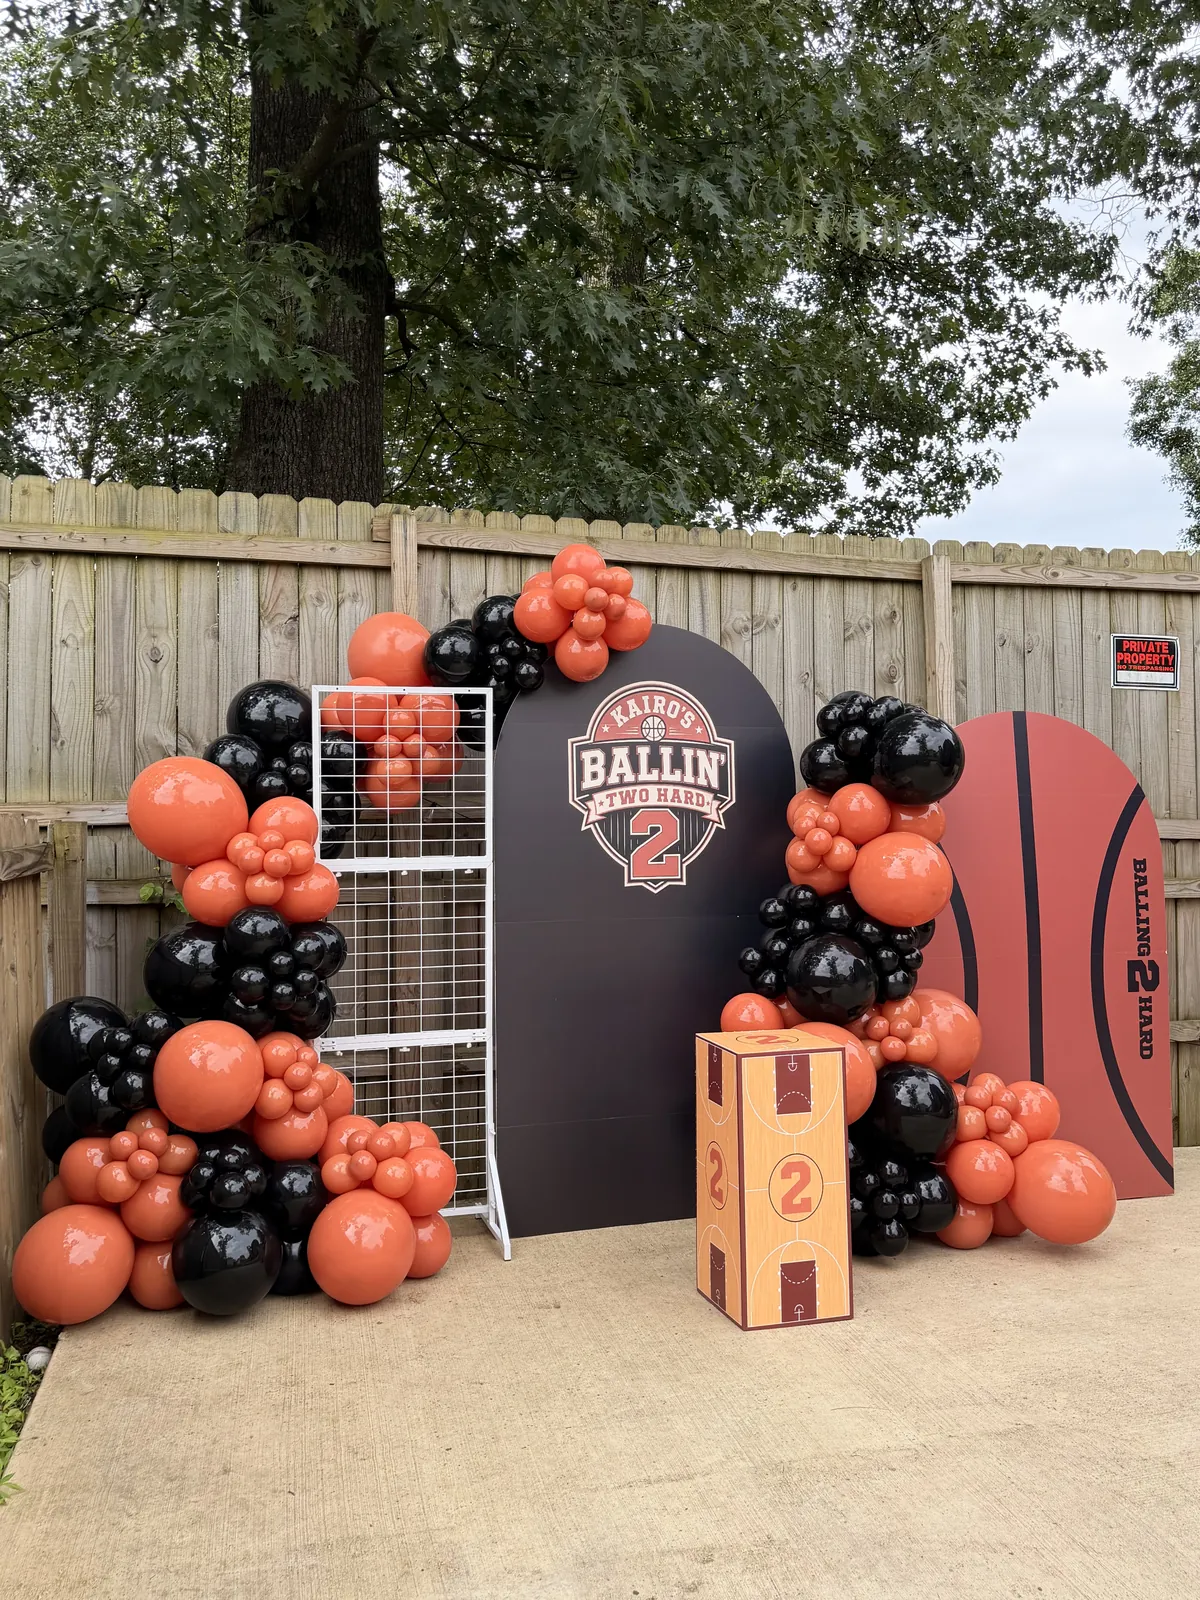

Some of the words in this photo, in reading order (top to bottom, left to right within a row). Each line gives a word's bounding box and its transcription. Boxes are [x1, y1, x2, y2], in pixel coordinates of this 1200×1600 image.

[1117, 653, 1174, 666] PROPERTY
[1123, 640, 1169, 653] PRIVATE
[610, 695, 696, 728] KAIRO'S
[580, 745, 727, 790] BALLIN'
[606, 788, 650, 808] TWO
[656, 788, 706, 808] HARD
[630, 808, 681, 880] 2
[1132, 858, 1151, 957] BALLING
[1127, 959, 1160, 993] 2
[1138, 996, 1154, 1060] HARD
[709, 1147, 724, 1206] 2
[780, 1160, 812, 1215] 2
